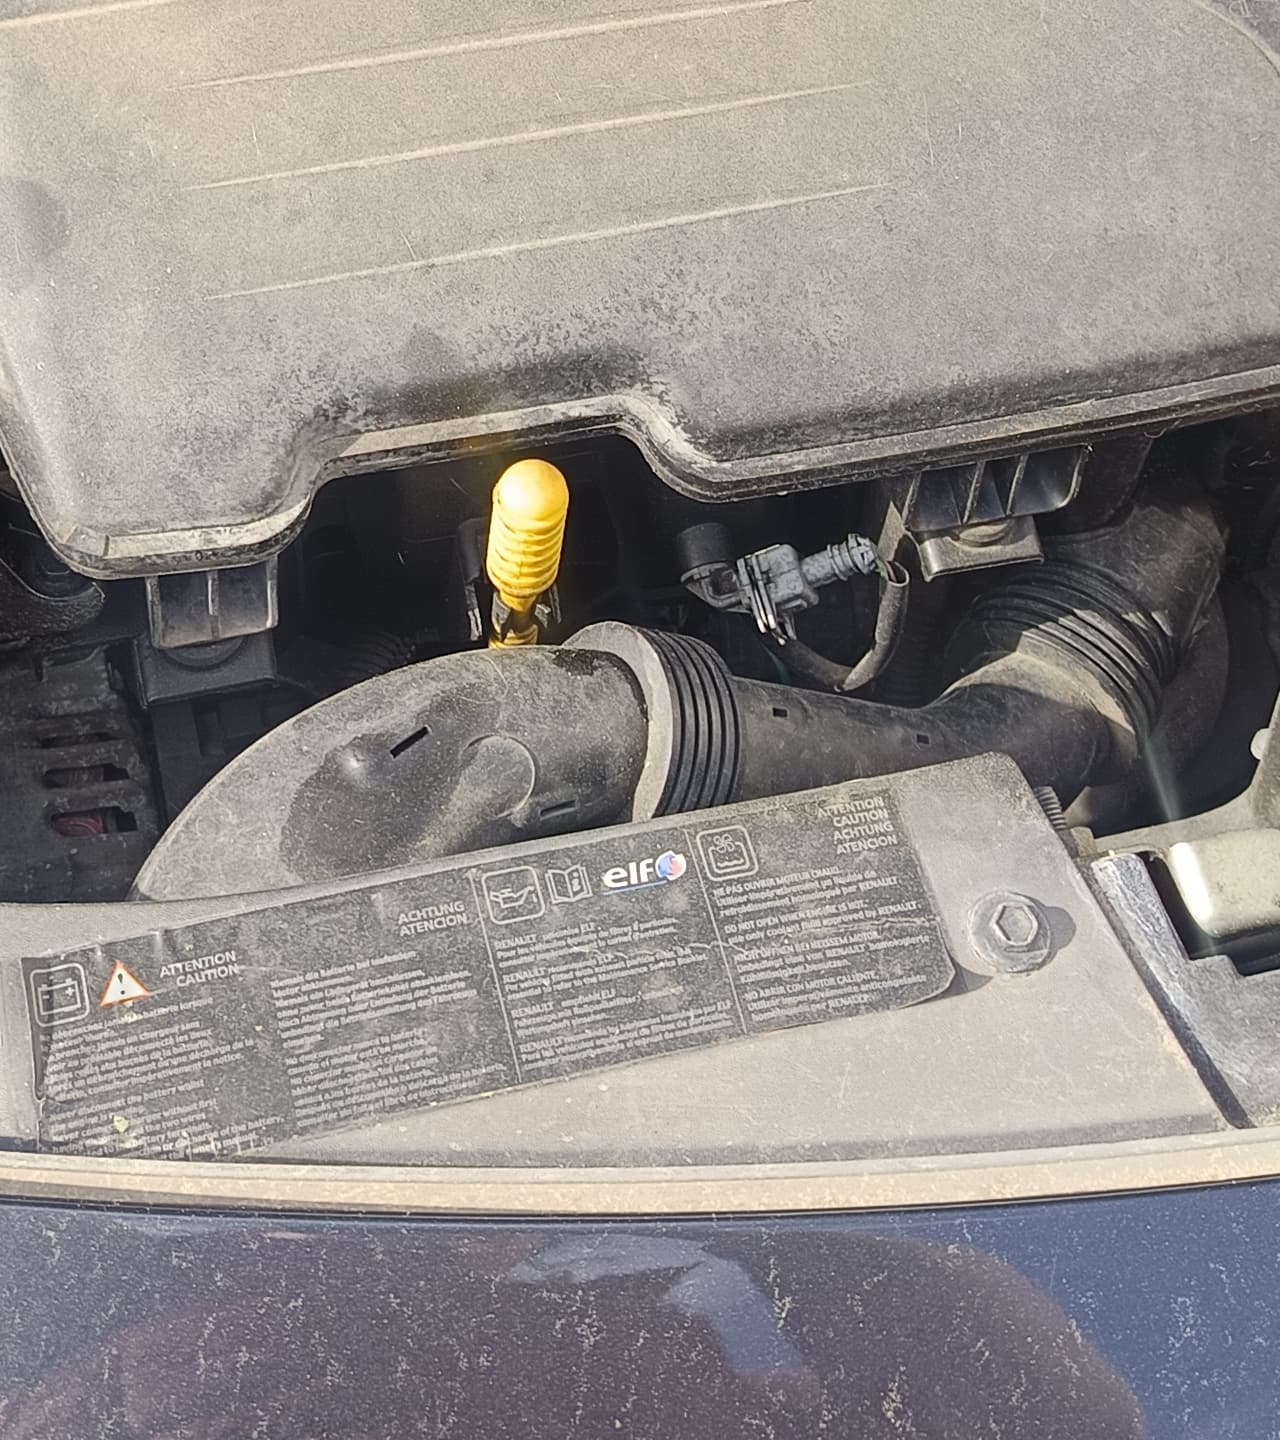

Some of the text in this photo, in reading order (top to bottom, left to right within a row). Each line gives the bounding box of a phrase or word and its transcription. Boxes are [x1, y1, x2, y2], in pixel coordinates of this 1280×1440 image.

[816, 796, 883, 818] ATTENTION
[833, 808, 887, 827] CAUTION
[832, 820, 893, 841] ACHTUNG
[836, 834, 897, 855] ATENCION
[602, 858, 655, 888] elf
[397, 901, 464, 923] ACHTUNG
[399, 913, 467, 935] ATENCION
[158, 951, 236, 977] ATTENTION
[176, 964, 238, 986] CAUTION
